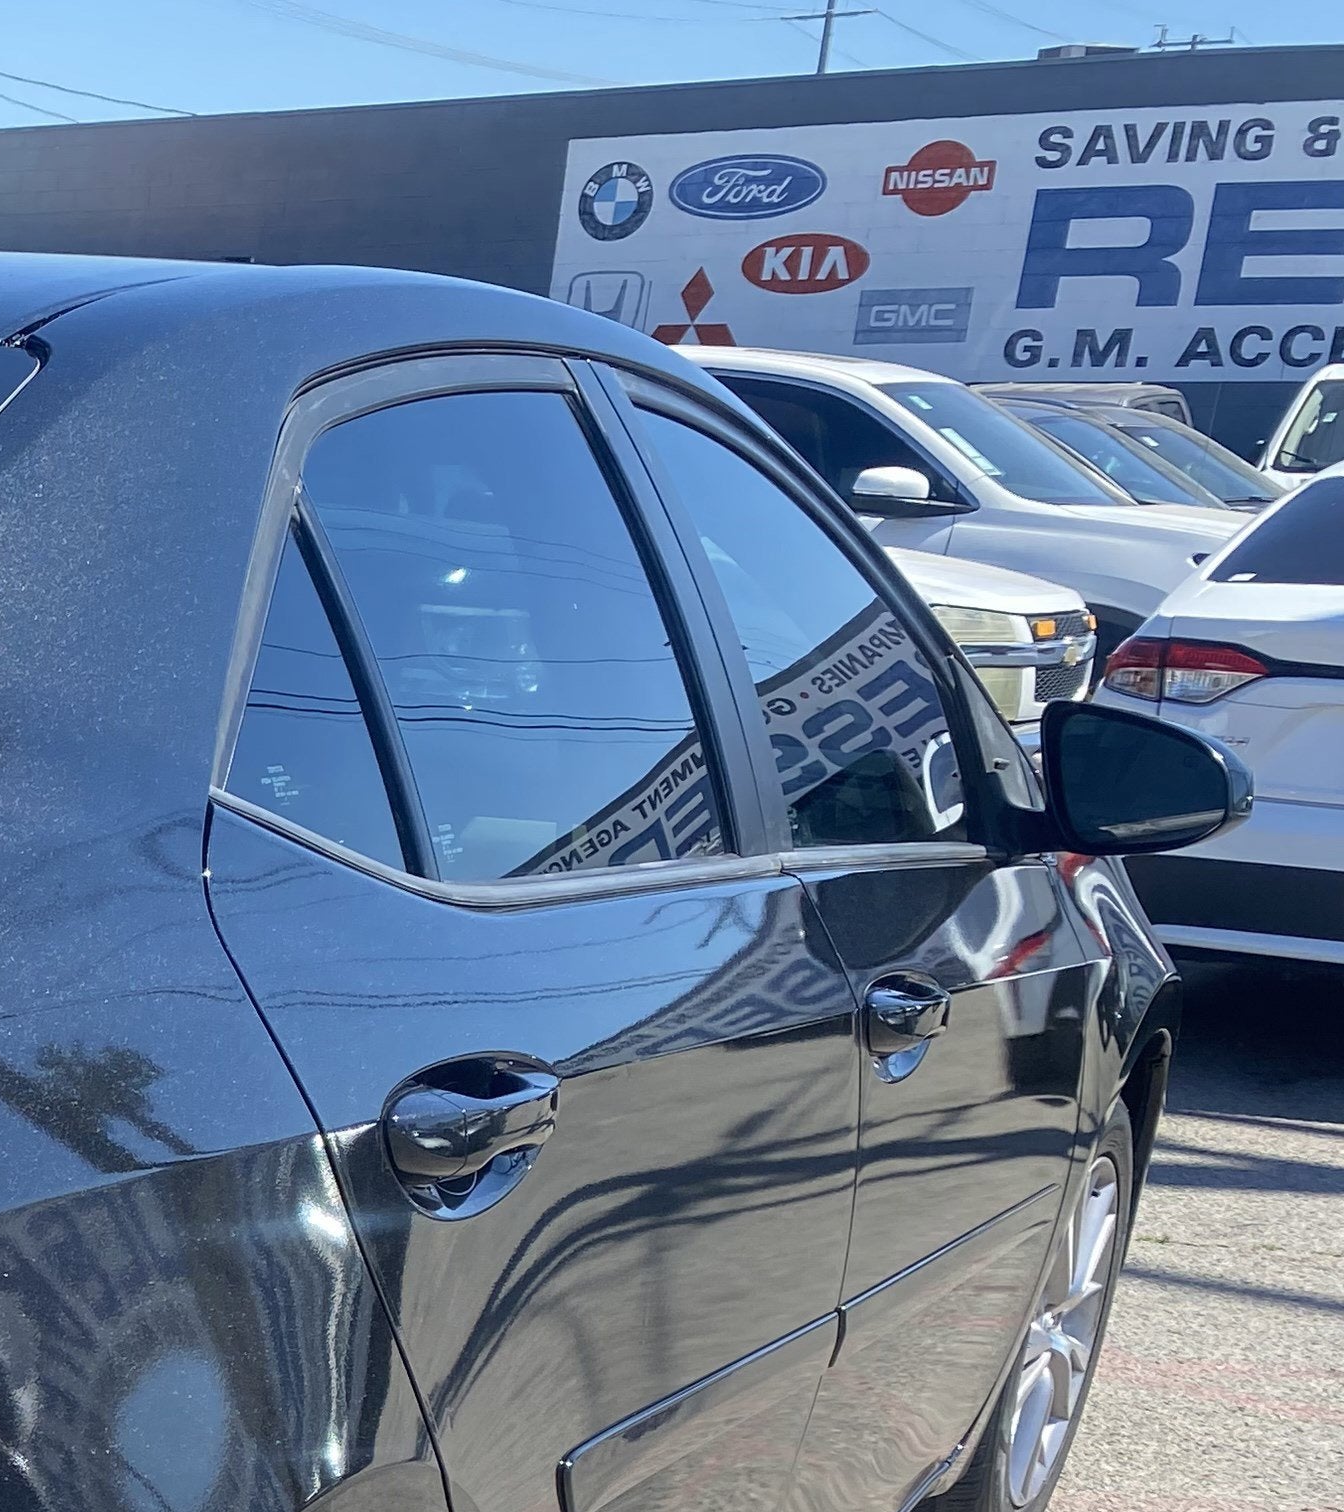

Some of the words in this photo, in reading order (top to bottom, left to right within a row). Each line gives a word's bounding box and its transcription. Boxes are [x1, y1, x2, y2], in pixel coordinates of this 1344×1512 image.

[1034, 117, 1276, 170] SAVING
[1302, 115, 1343, 159] &
[701, 167, 793, 205] Ford
[888, 165, 989, 191] NISSAN
[760, 245, 850, 281] KIA
[868, 303, 957, 328] GMC
[1003, 327, 1150, 369] G.M.
